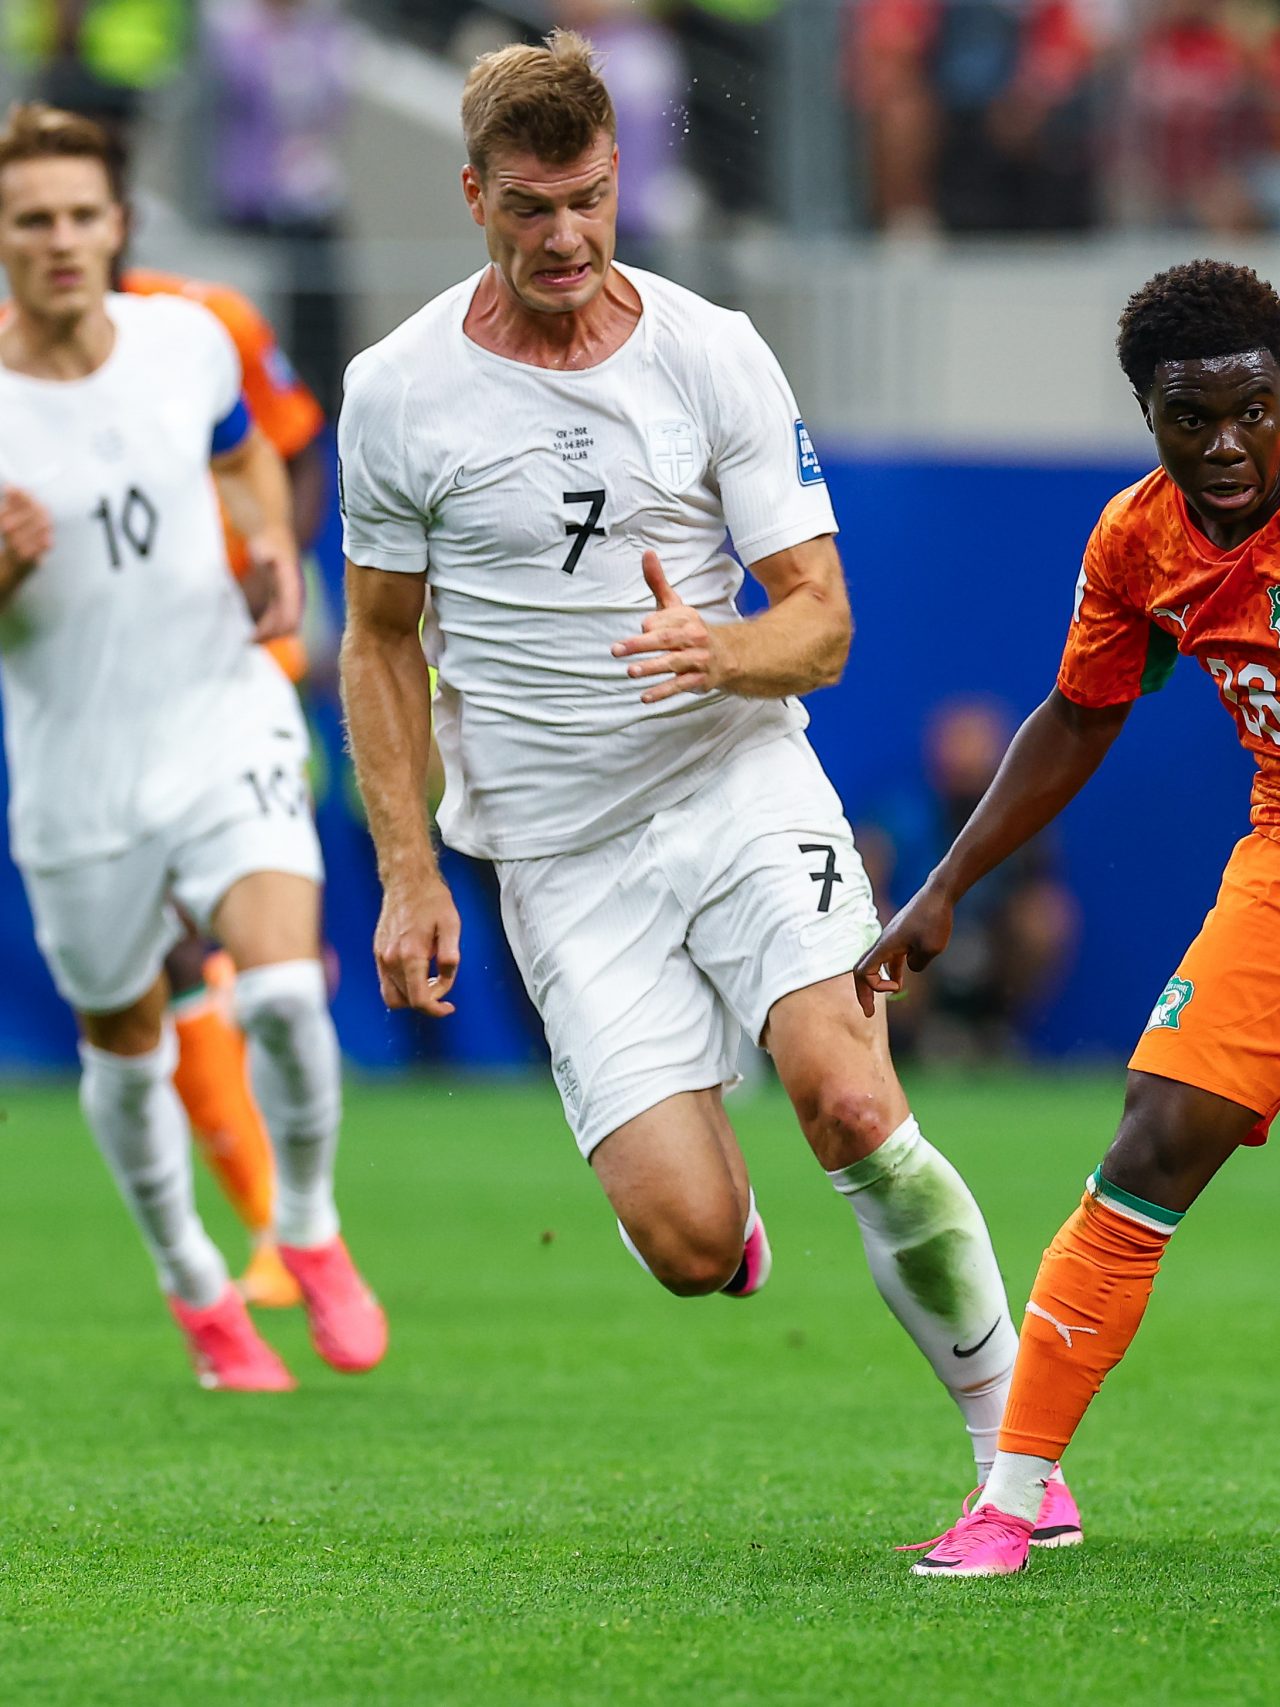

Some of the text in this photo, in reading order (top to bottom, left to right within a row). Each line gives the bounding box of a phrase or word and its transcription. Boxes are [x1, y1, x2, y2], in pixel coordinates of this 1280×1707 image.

[562, 450, 588, 461] DALLAS
[91, 485, 158, 572] 10
[562, 489, 606, 575] 7
[239, 764, 304, 818] 10
[798, 843, 843, 913] 7
